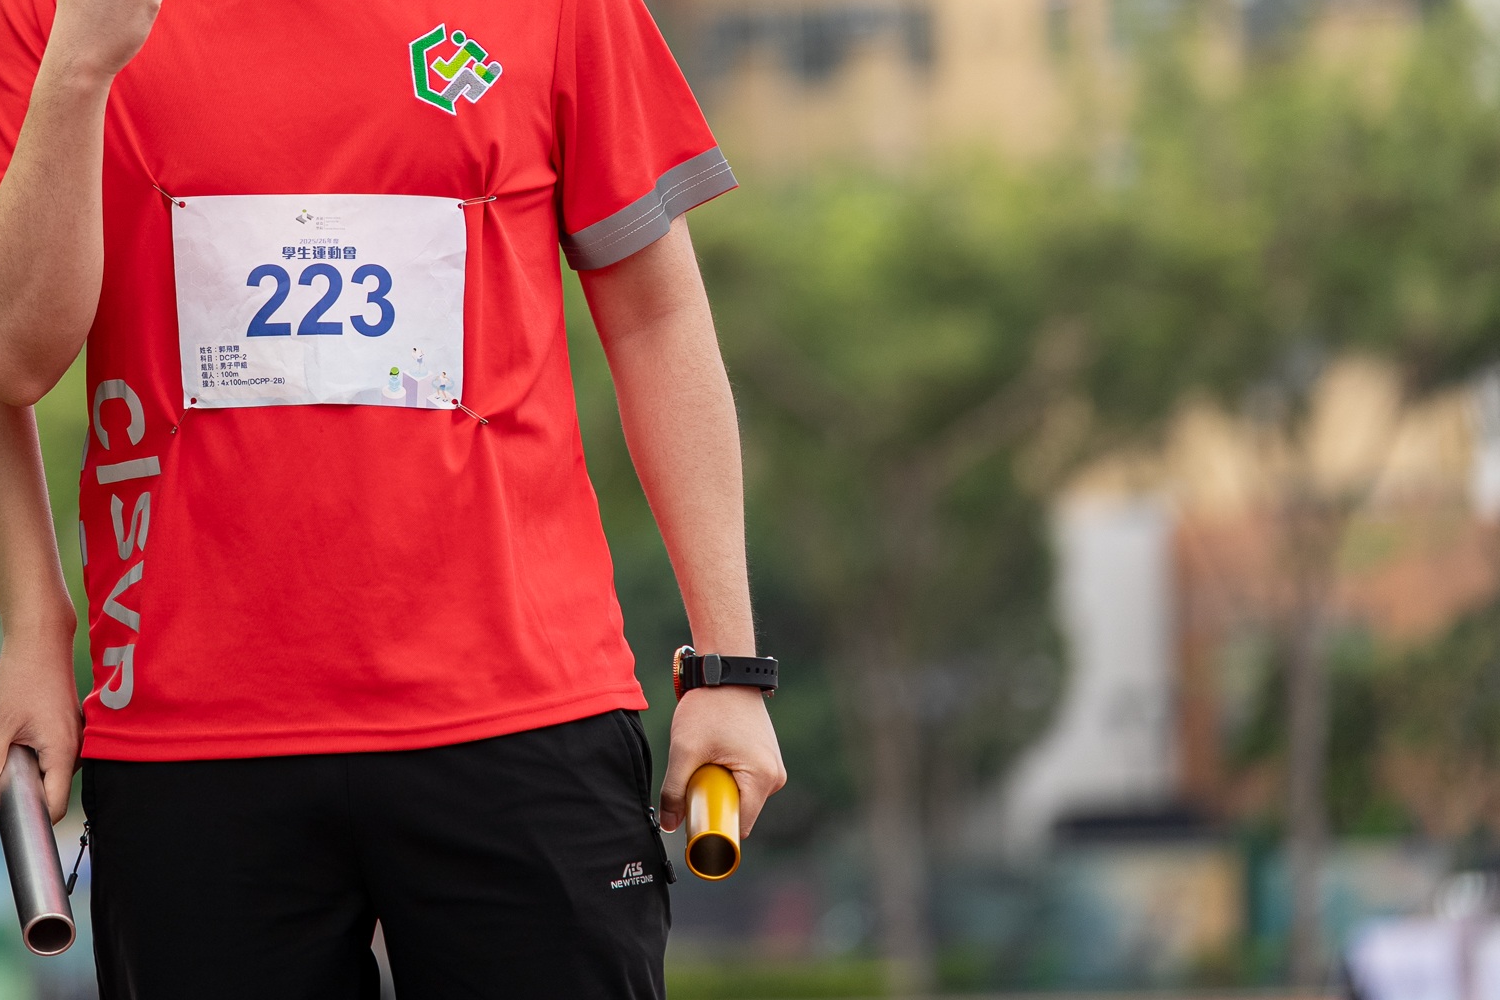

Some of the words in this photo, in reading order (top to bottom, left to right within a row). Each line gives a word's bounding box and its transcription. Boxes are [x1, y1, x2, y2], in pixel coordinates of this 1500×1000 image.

[282, 246, 357, 260] 學生運動會
[246, 263, 396, 337] 223
